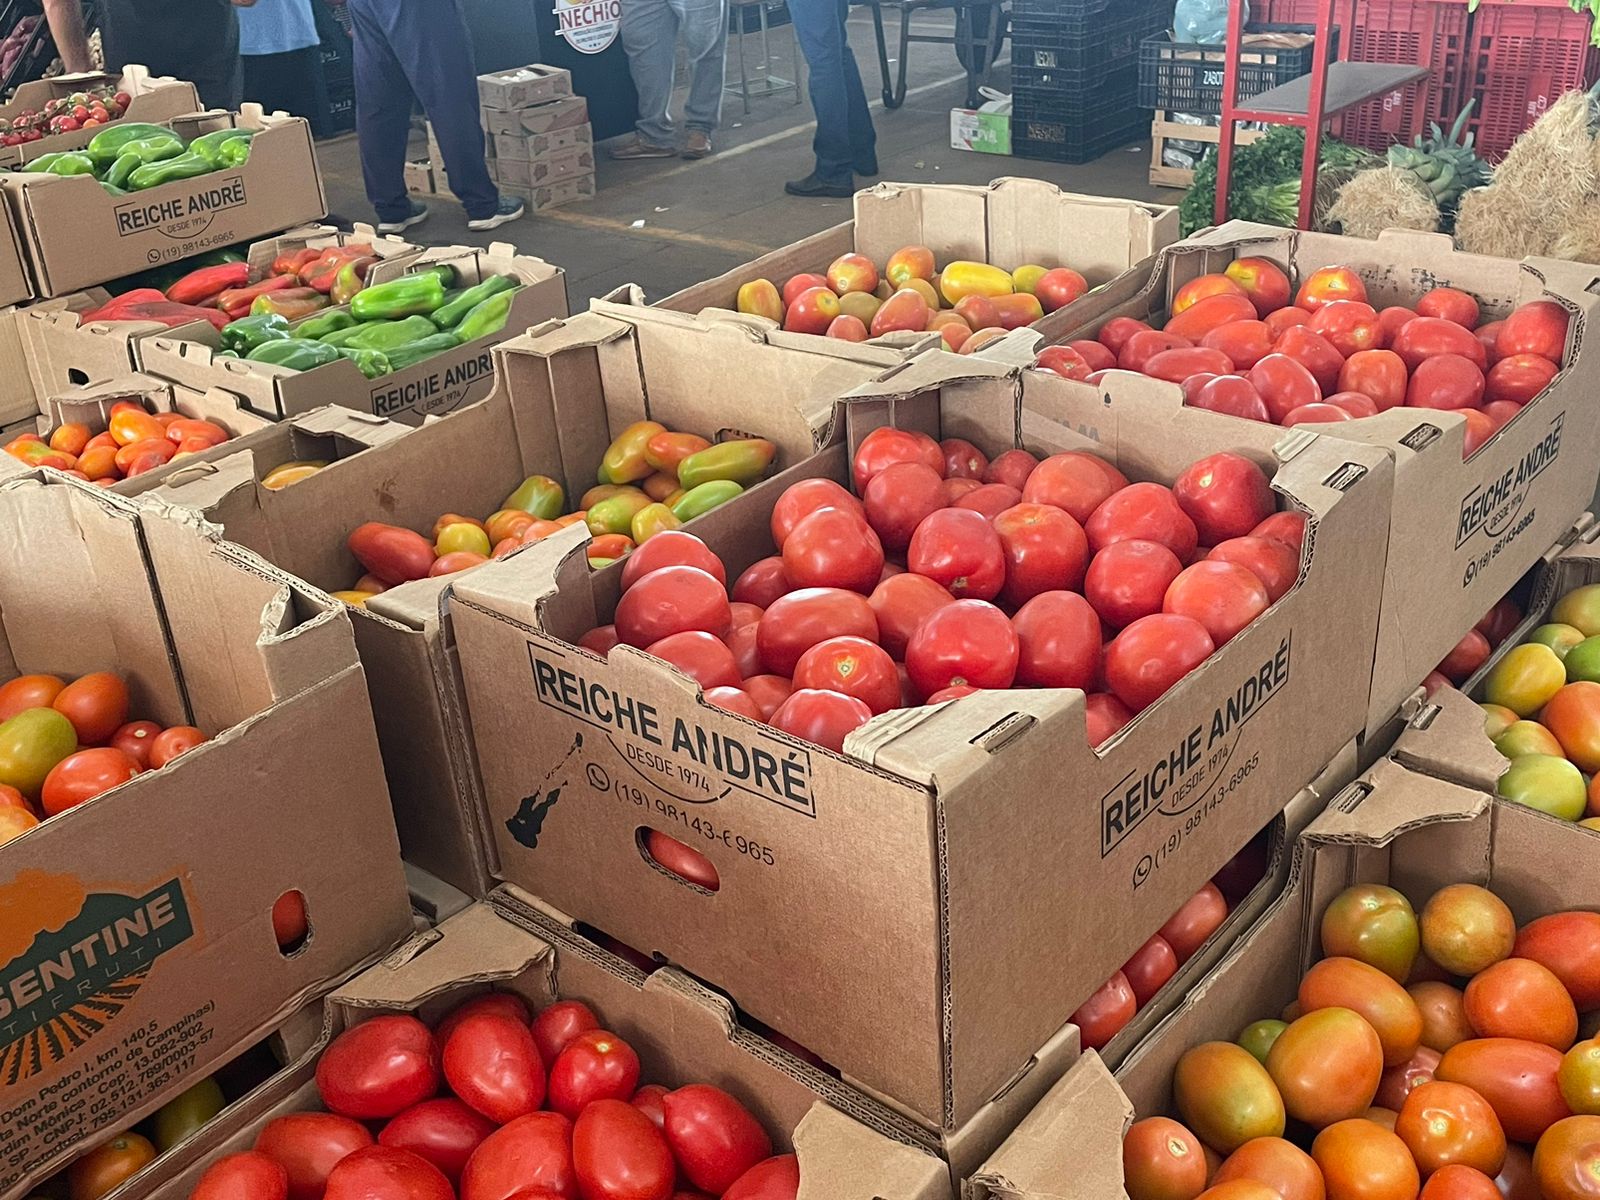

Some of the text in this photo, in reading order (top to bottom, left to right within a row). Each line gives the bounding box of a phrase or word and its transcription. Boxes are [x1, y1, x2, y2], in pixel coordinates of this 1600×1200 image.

[561, 1, 621, 29] NECHIO
[119, 180, 244, 232] REICHE ANDRÉ
[167, 221, 190, 233] DESDE
[162, 231, 235, 260] (19) 98143-6965
[374, 374, 440, 416] REICHE
[1458, 418, 1561, 541] REICHE ANDRÉ
[1490, 503, 1510, 529] DESDE
[1474, 549, 1491, 577] (19)
[535, 658, 809, 805] REICHE ANDRÉ
[1105, 638, 1287, 846] REICHE ANDRÉ
[626, 743, 710, 793] DESDE 1974
[1171, 744, 1229, 808] DESDE 1974
[614, 780, 650, 812] (19)
[1155, 751, 1260, 868] (19) 98143-6965
[1, 1099, 36, 1124] Dom
[39, 1067, 84, 1100] Pedro
[96, 1047, 118, 1065] km
[122, 1020, 158, 1048] 140,5
[17, 1101, 58, 1130] Norte
[61, 1060, 123, 1102] contorno
[126, 1046, 143, 1062] de
[145, 1000, 216, 1049] Campinas)
[34, 1099, 87, 1135] Mônica
[97, 1070, 129, 1095] Cep:
[133, 1021, 204, 1072] 13.082-902
[8, 1148, 30, 1167] SP
[43, 1112, 88, 1144] CNPJ:
